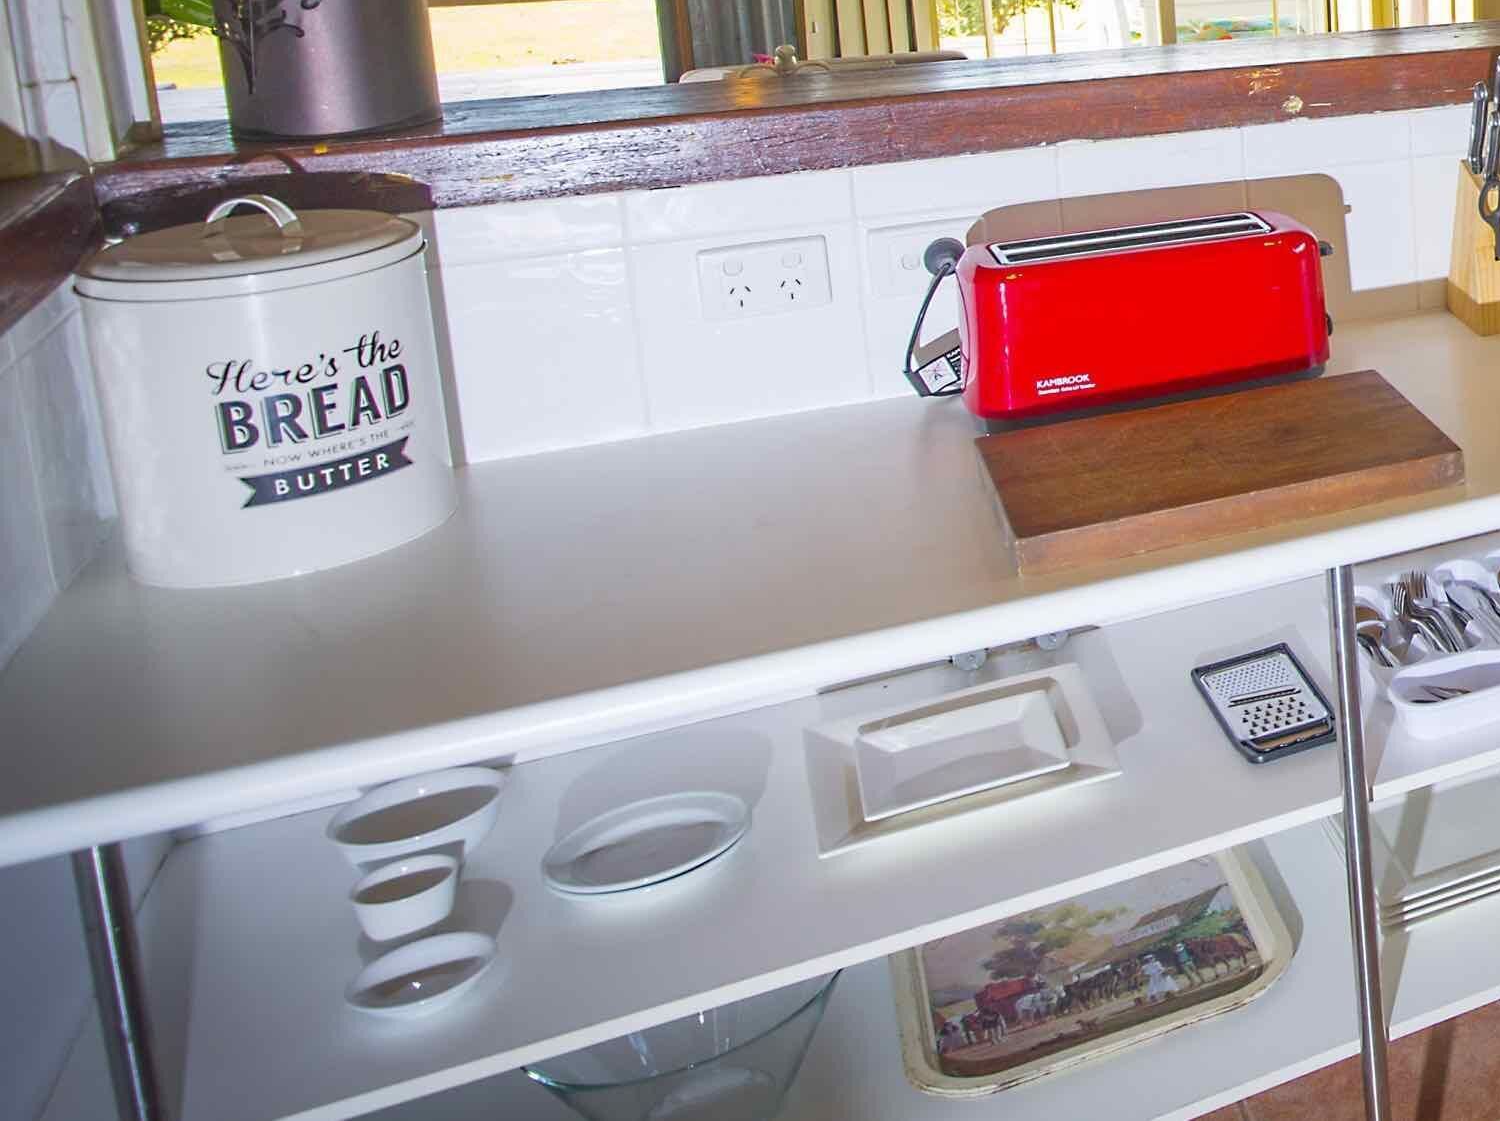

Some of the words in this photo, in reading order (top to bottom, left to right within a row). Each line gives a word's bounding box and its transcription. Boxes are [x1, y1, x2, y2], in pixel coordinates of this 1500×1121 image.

[206, 354, 339, 395] Here's
[343, 330, 403, 368] the
[1036, 374, 1089, 389] KAMBROOK
[214, 364, 410, 455] BREAD
[263, 452, 302, 467] NOW
[307, 437, 367, 459] WHERE'S
[370, 430, 389, 444] THE
[275, 453, 390, 495] BUTTER
